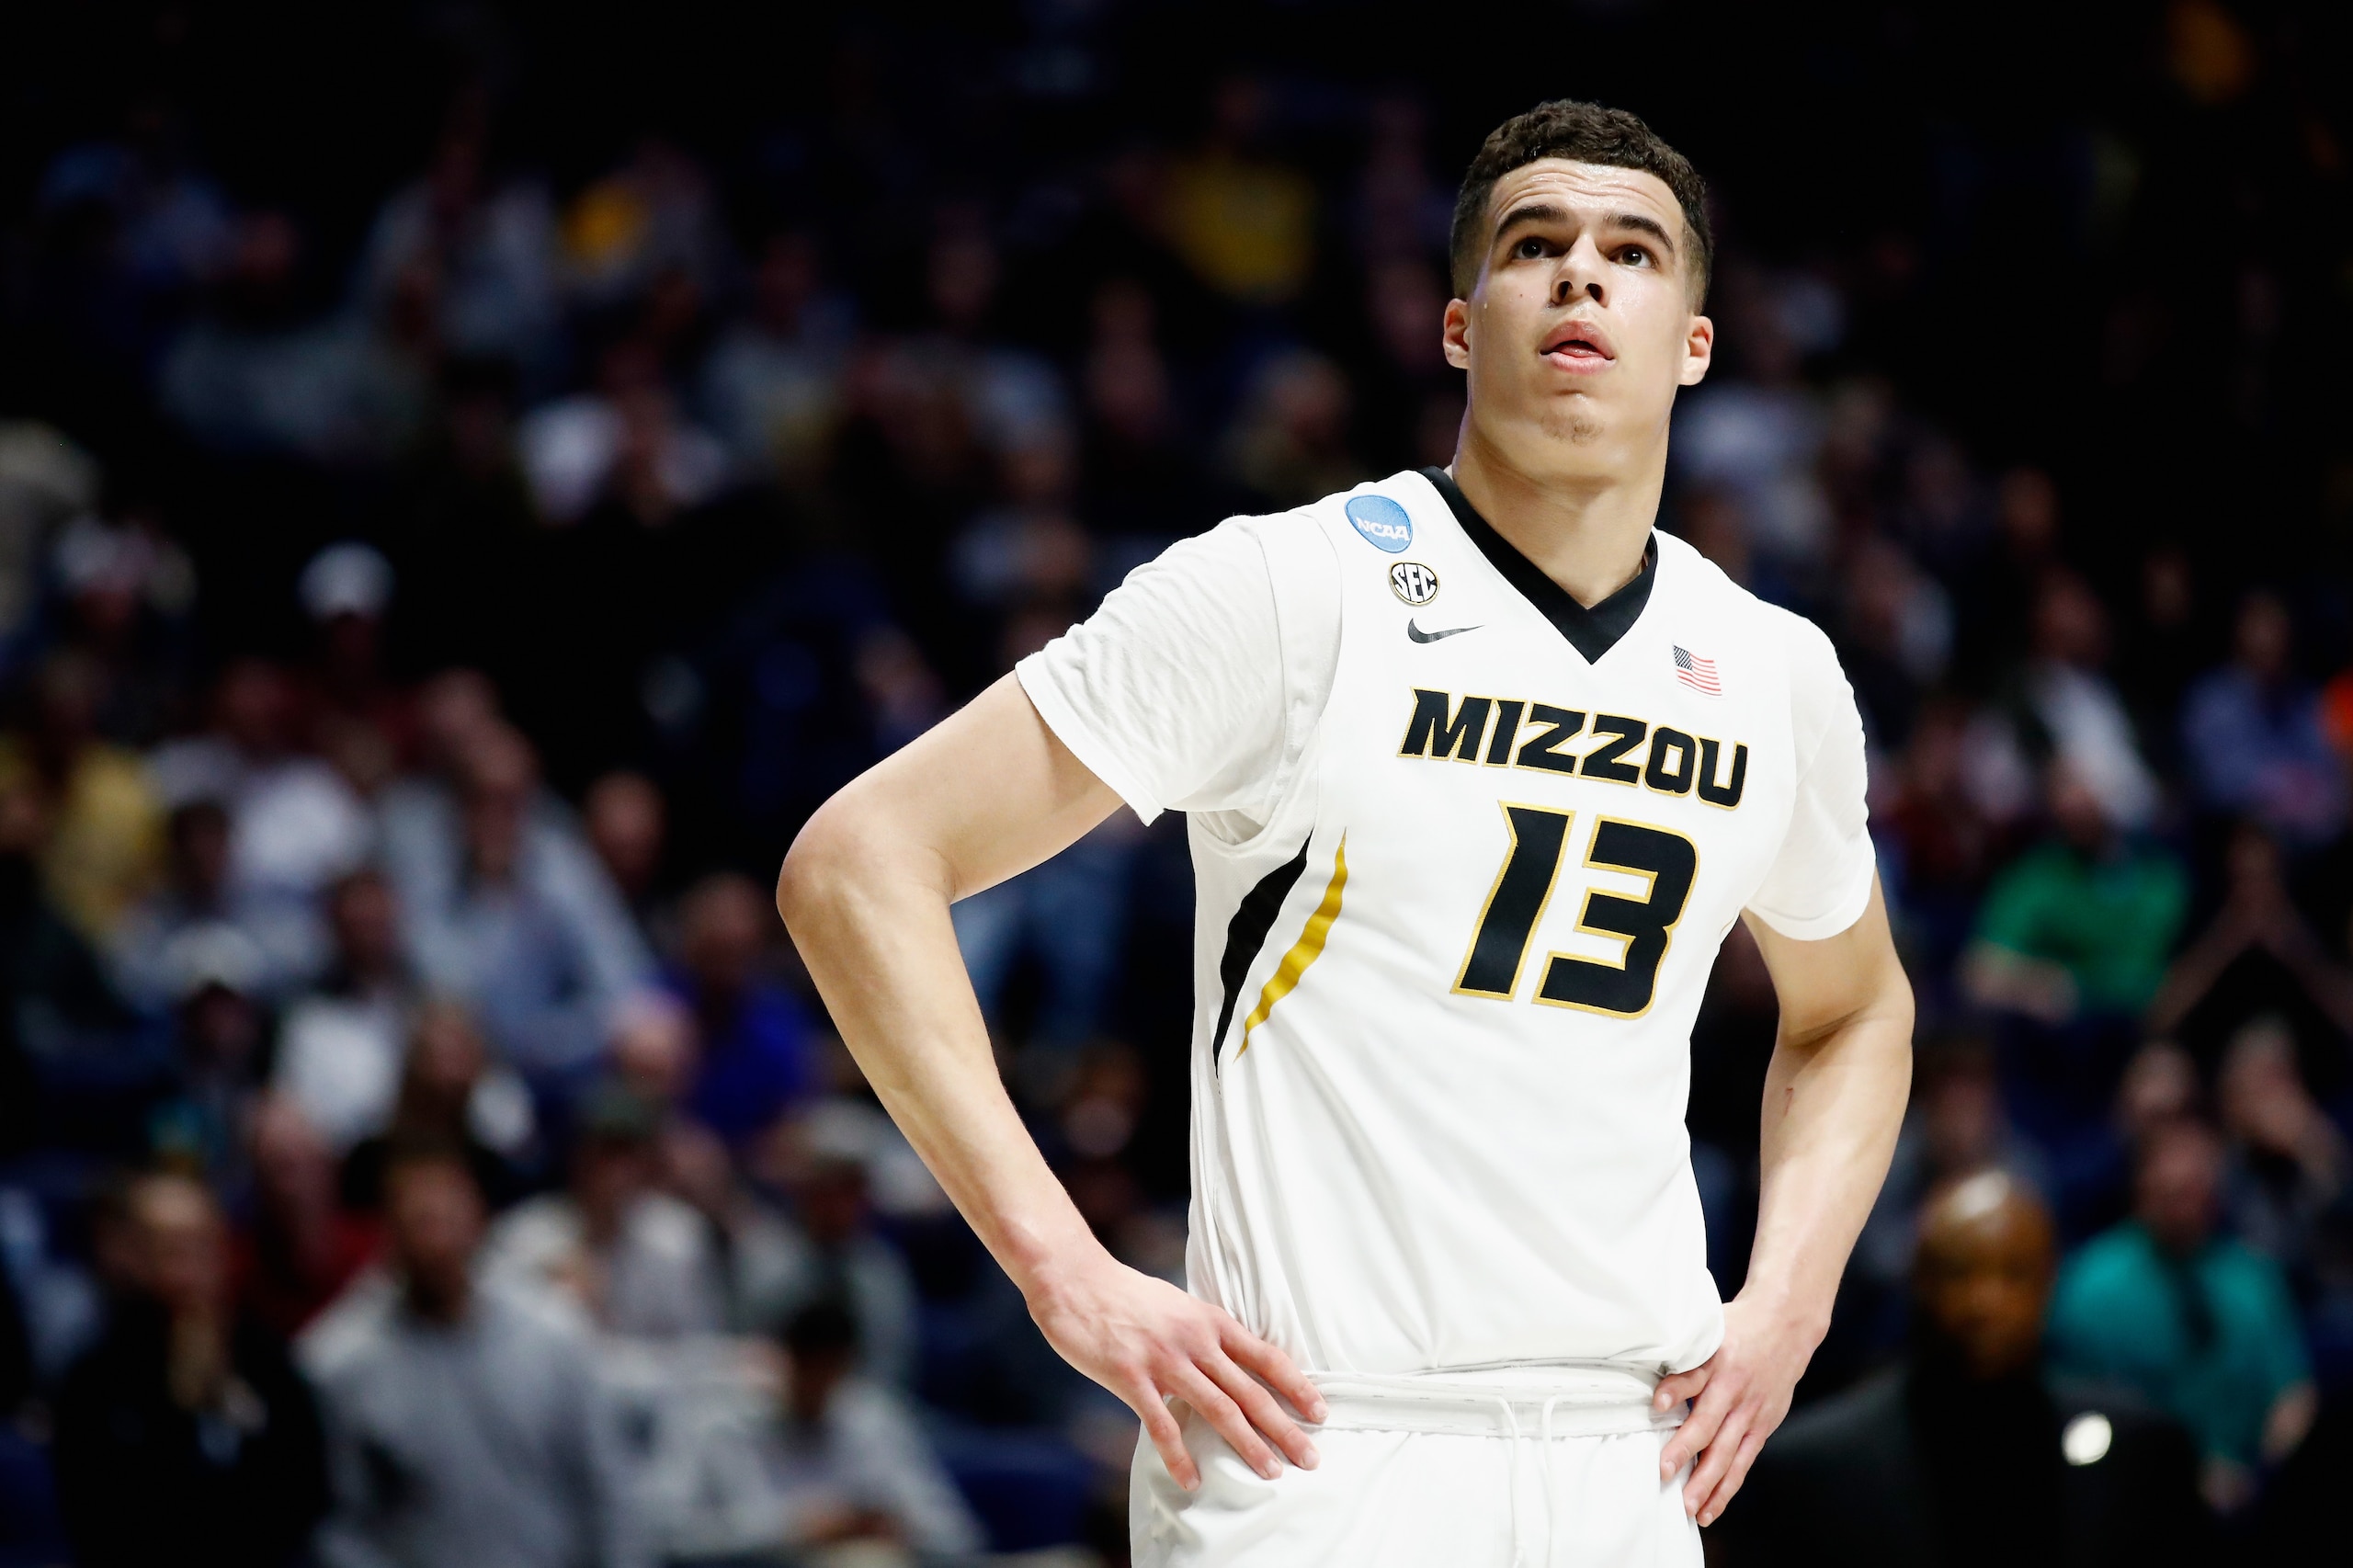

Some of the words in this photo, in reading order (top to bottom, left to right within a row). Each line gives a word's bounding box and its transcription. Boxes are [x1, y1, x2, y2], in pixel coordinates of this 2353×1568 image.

[1357, 518, 1410, 540] NCAA
[1391, 562, 1438, 603] SEC
[1397, 687, 1748, 810] MIZZOU
[1450, 801, 1699, 1018] 13
